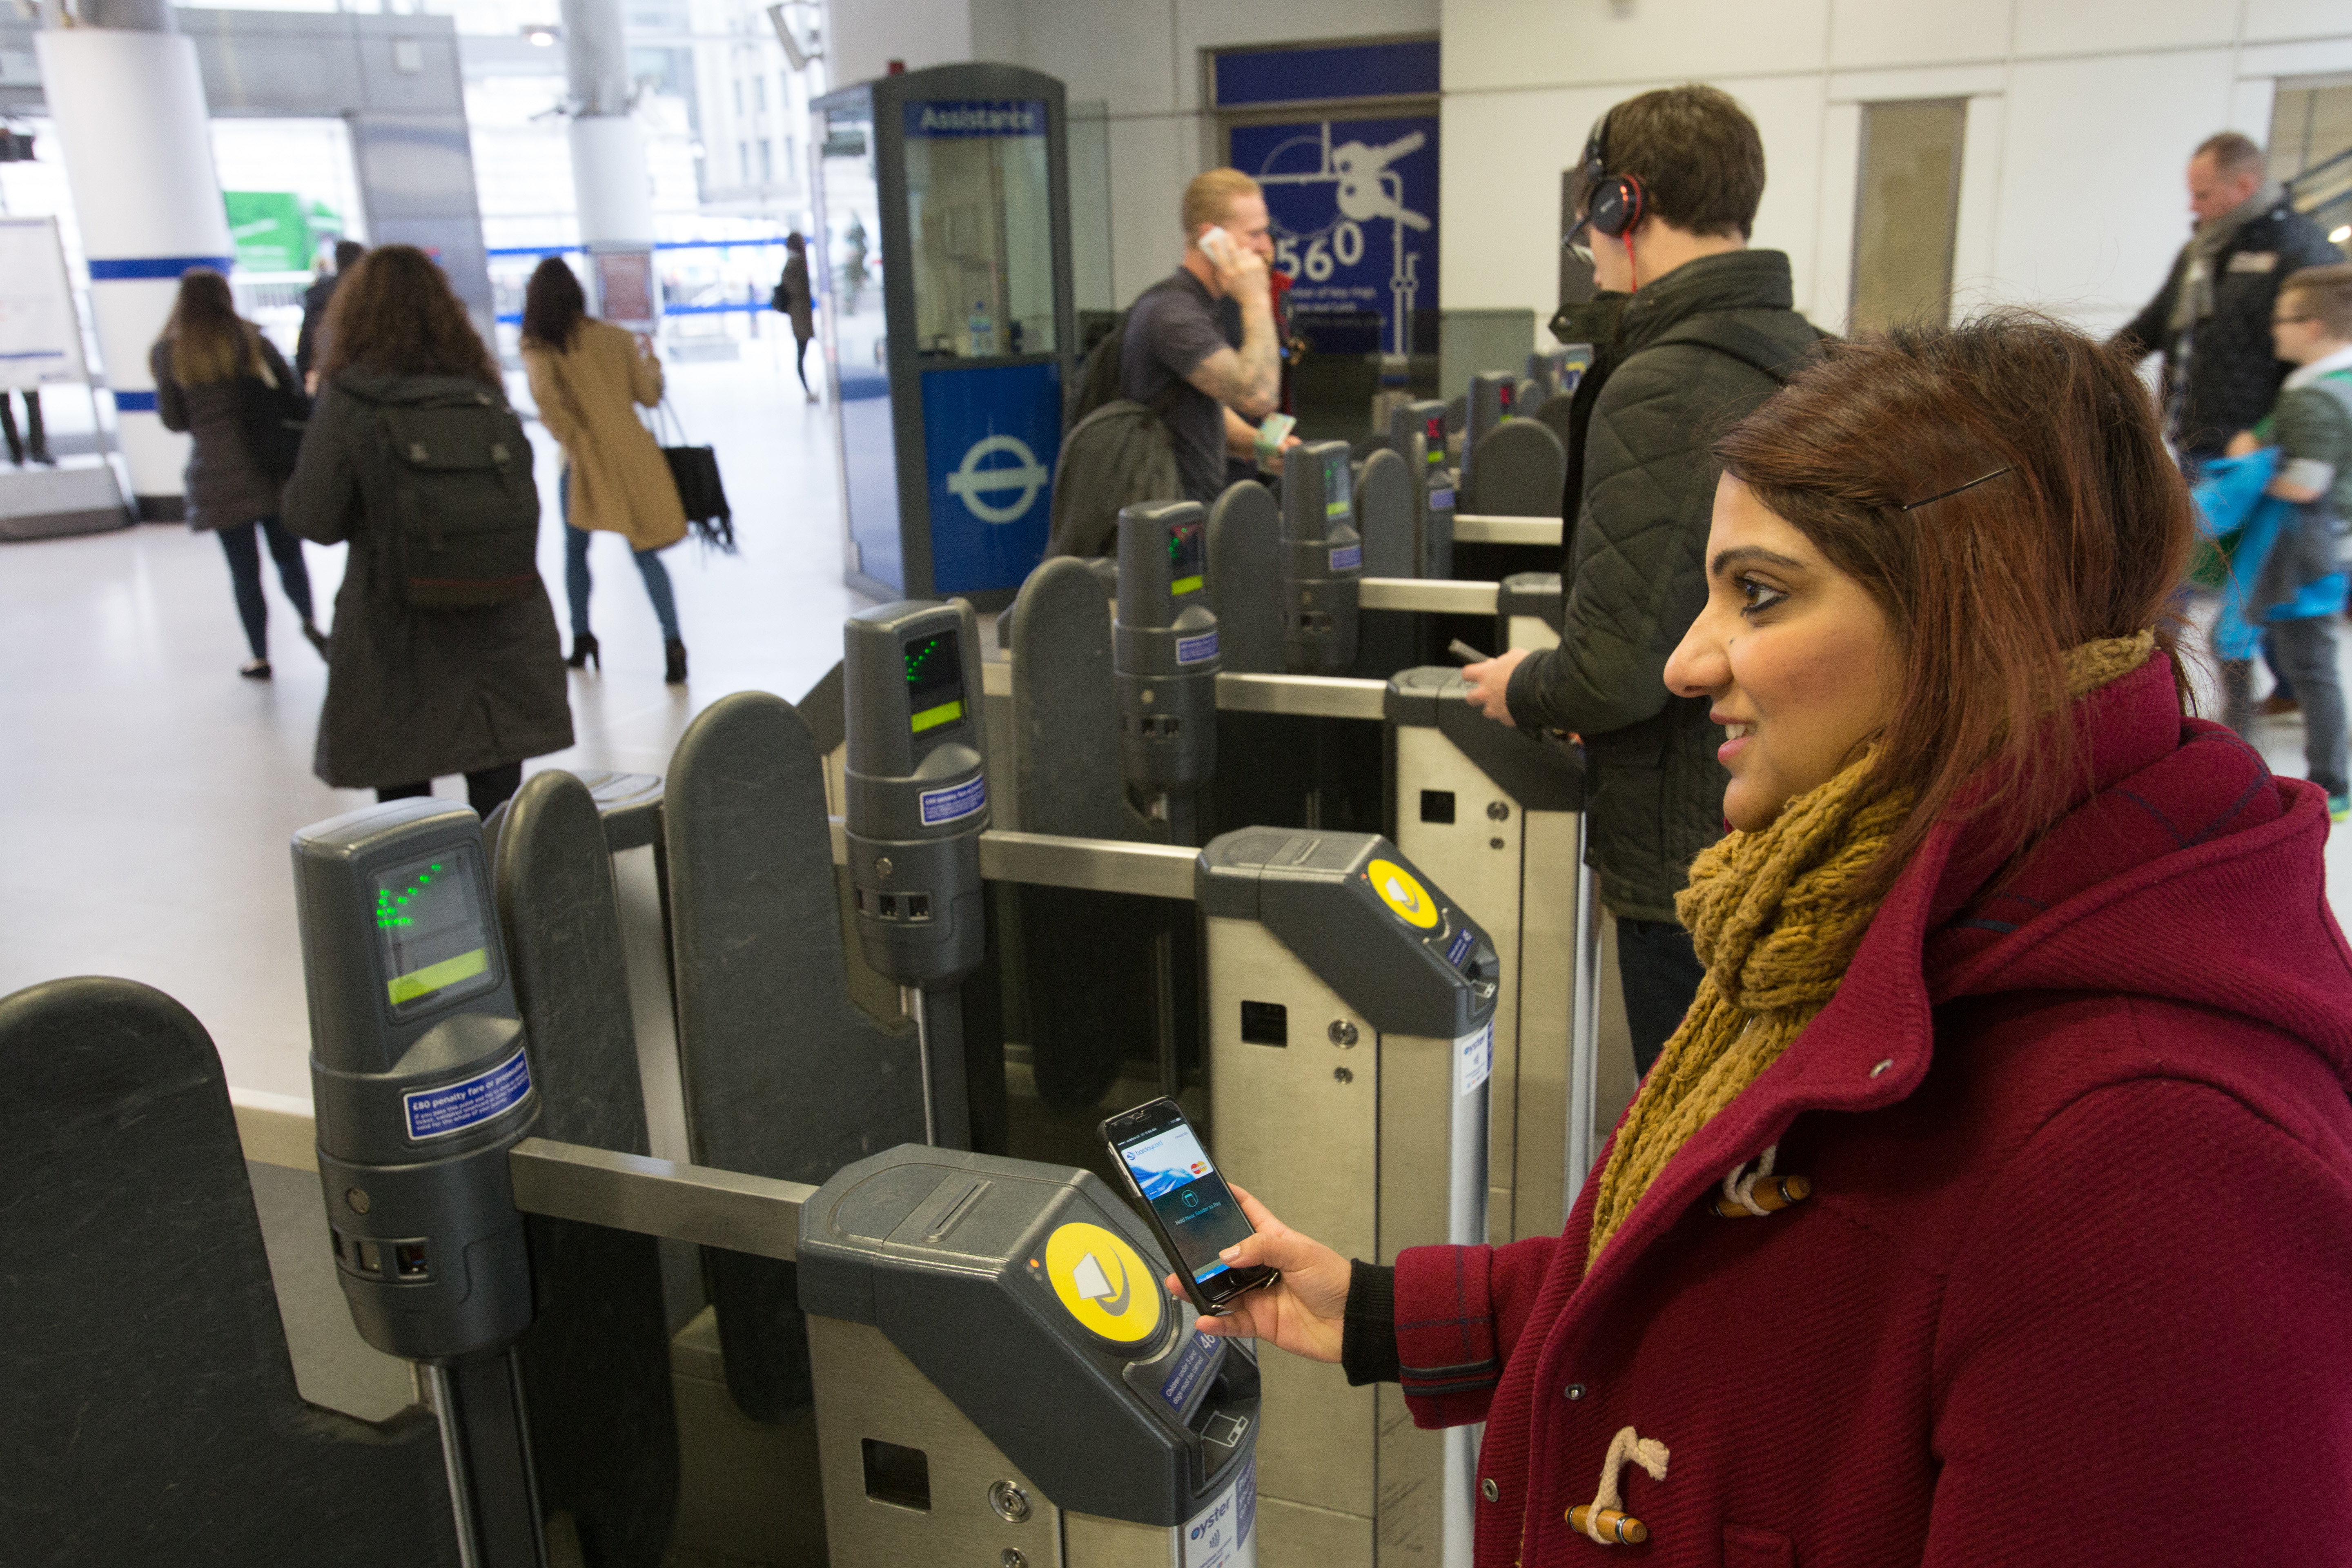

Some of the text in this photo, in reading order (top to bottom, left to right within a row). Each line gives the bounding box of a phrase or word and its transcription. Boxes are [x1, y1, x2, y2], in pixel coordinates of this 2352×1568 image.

[920, 106, 1034, 129] Assistance
[412, 1100, 430, 1111] £80
[432, 1092, 466, 1108] penalty
[468, 1085, 485, 1096] fare
[486, 1080, 494, 1089] or
[495, 1060, 524, 1085] prosecution
[1135, 1140, 1163, 1156] barclaycard
[1194, 1207, 1209, 1216] Reader
[1166, 1376, 1181, 1396] Children
[1178, 1363, 1189, 1378] under
[1173, 1391, 1183, 1404] dogs
[1180, 1378, 1191, 1391] must
[1192, 1355, 1204, 1374] carried
[1191, 1494, 1232, 1540] oyster
